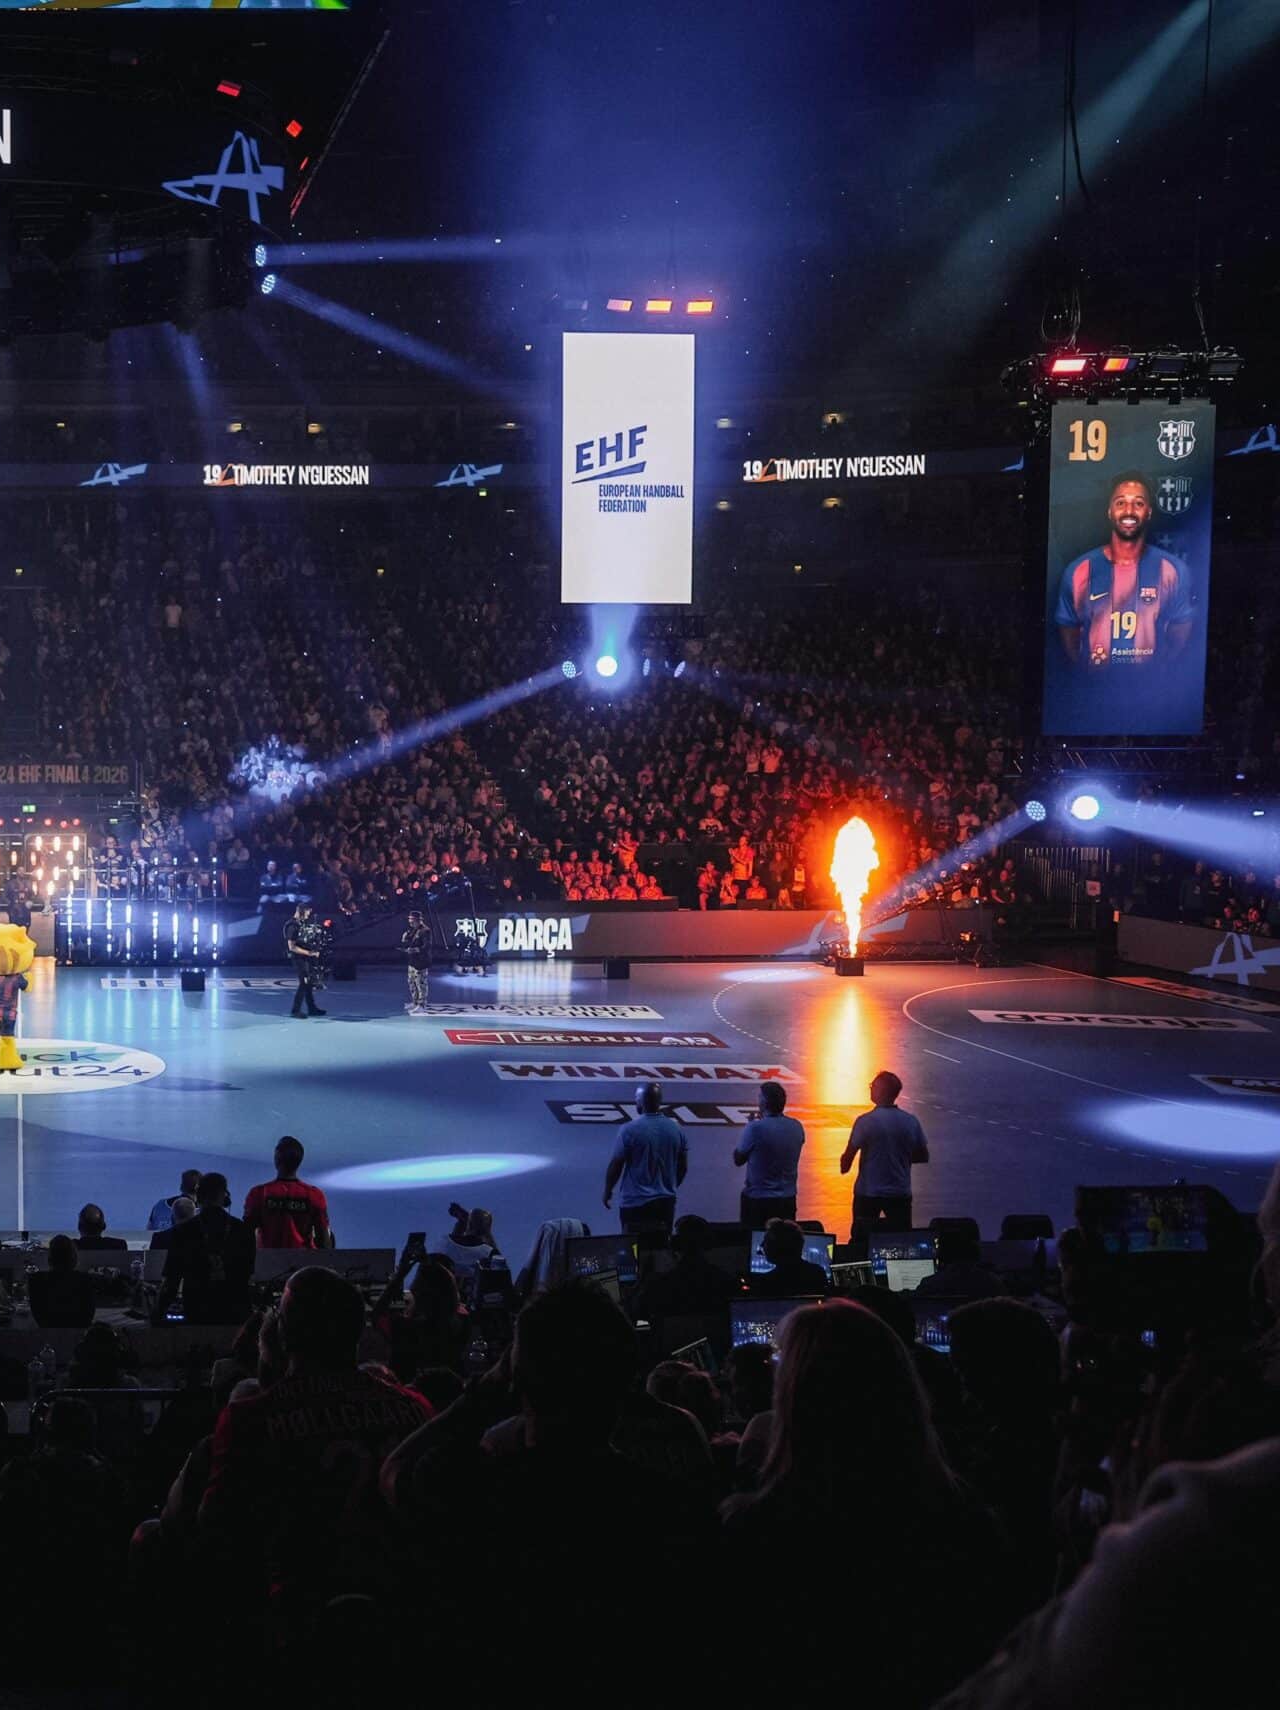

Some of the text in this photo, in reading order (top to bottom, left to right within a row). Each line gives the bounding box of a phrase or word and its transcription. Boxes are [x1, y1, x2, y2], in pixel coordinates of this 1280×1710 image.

[576, 425, 647, 474] EHF
[1069, 420, 1107, 461] 19
[203, 464, 369, 486] 19 TIMOTHEY N'GUESSAN
[743, 454, 925, 481] 19 TIMOTHEY N'GUESSAN
[599, 484, 685, 498] EUROPEAN HANDBALL
[599, 499, 647, 512] FEDERATION
[1111, 611, 1137, 639] 19
[19, 765, 41, 783] EHF
[45, 766, 90, 784] FINAL4
[93, 766, 128, 784] 2026
[498, 917, 573, 958] BARÇA
[993, 1012, 1238, 1029] gorenje
[500, 1065, 791, 1080] WINAMAX
